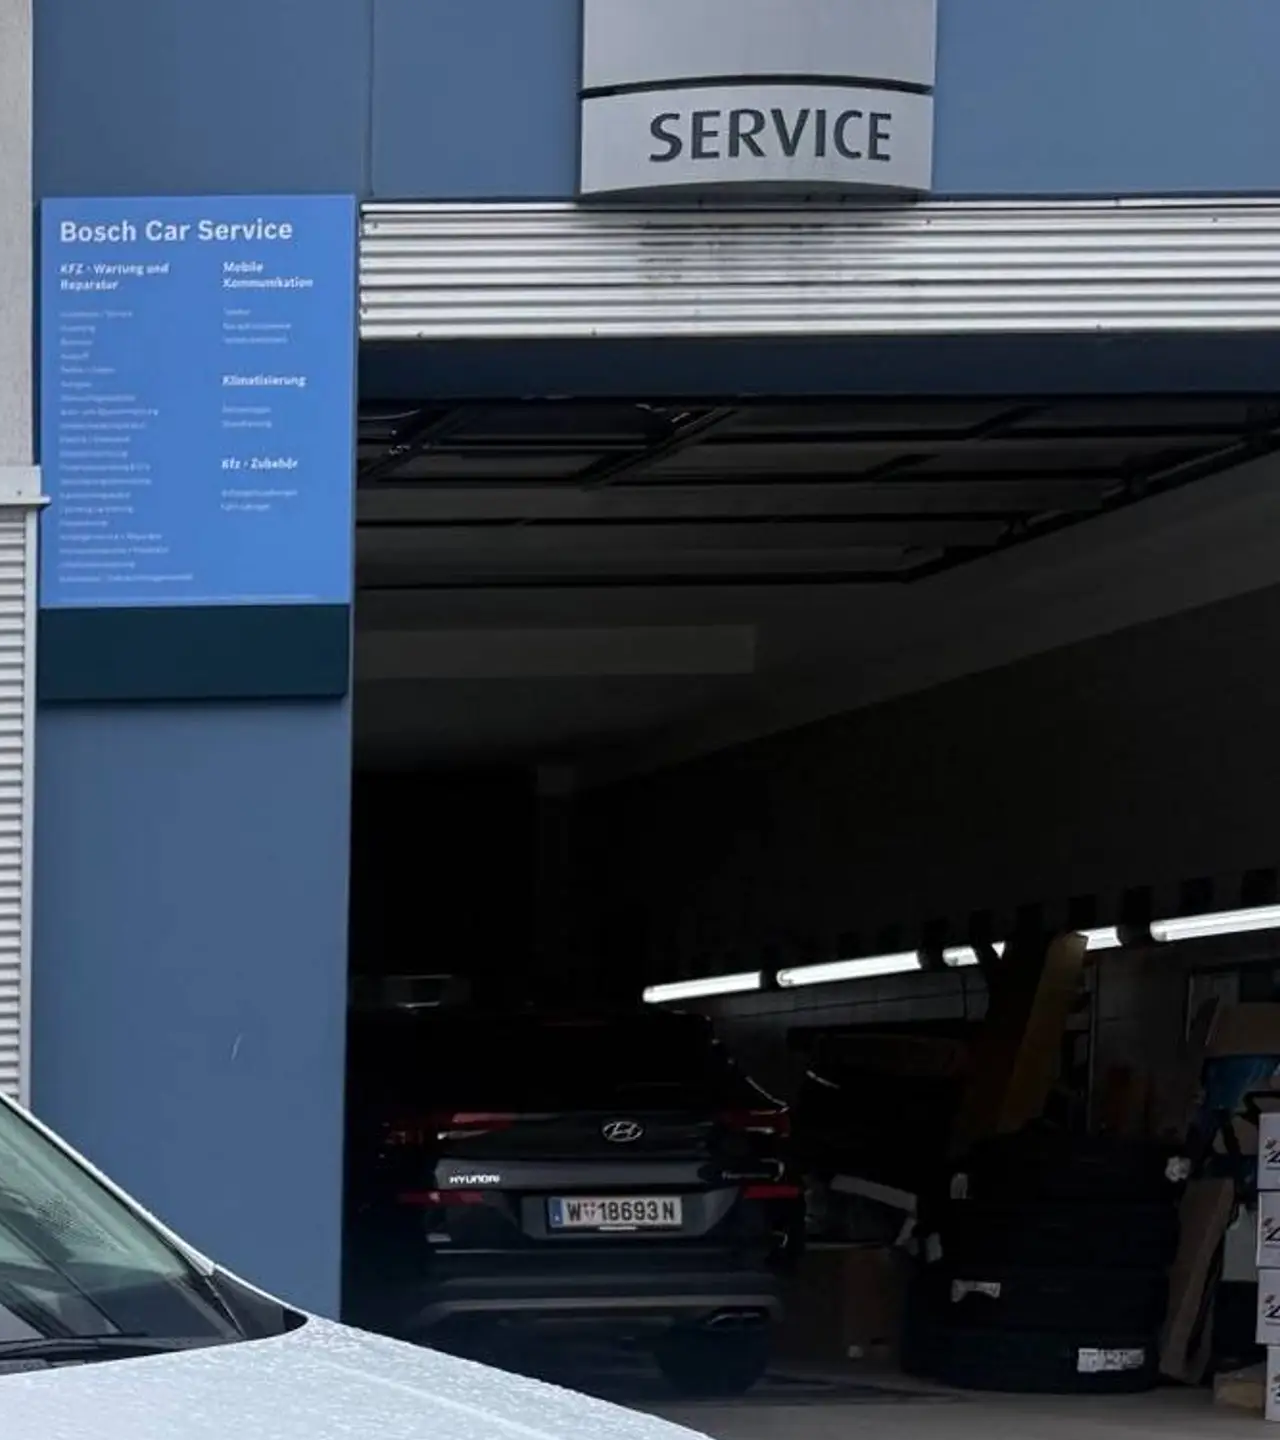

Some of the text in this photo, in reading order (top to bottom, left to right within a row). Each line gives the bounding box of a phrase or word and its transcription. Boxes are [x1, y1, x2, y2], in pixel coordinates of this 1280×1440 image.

[649, 108, 892, 163] SERVICE
[60, 217, 294, 243] Bosch Car Service
[94, 263, 143, 278] Wartung
[147, 262, 169, 275] und
[223, 261, 263, 273] Mobile
[59, 279, 119, 292] Reparatur
[223, 276, 314, 289] Kommunikation
[223, 374, 307, 388] Klimatisierung
[251, 457, 299, 471] Zubehör
[567, 1202, 581, 1221] W
